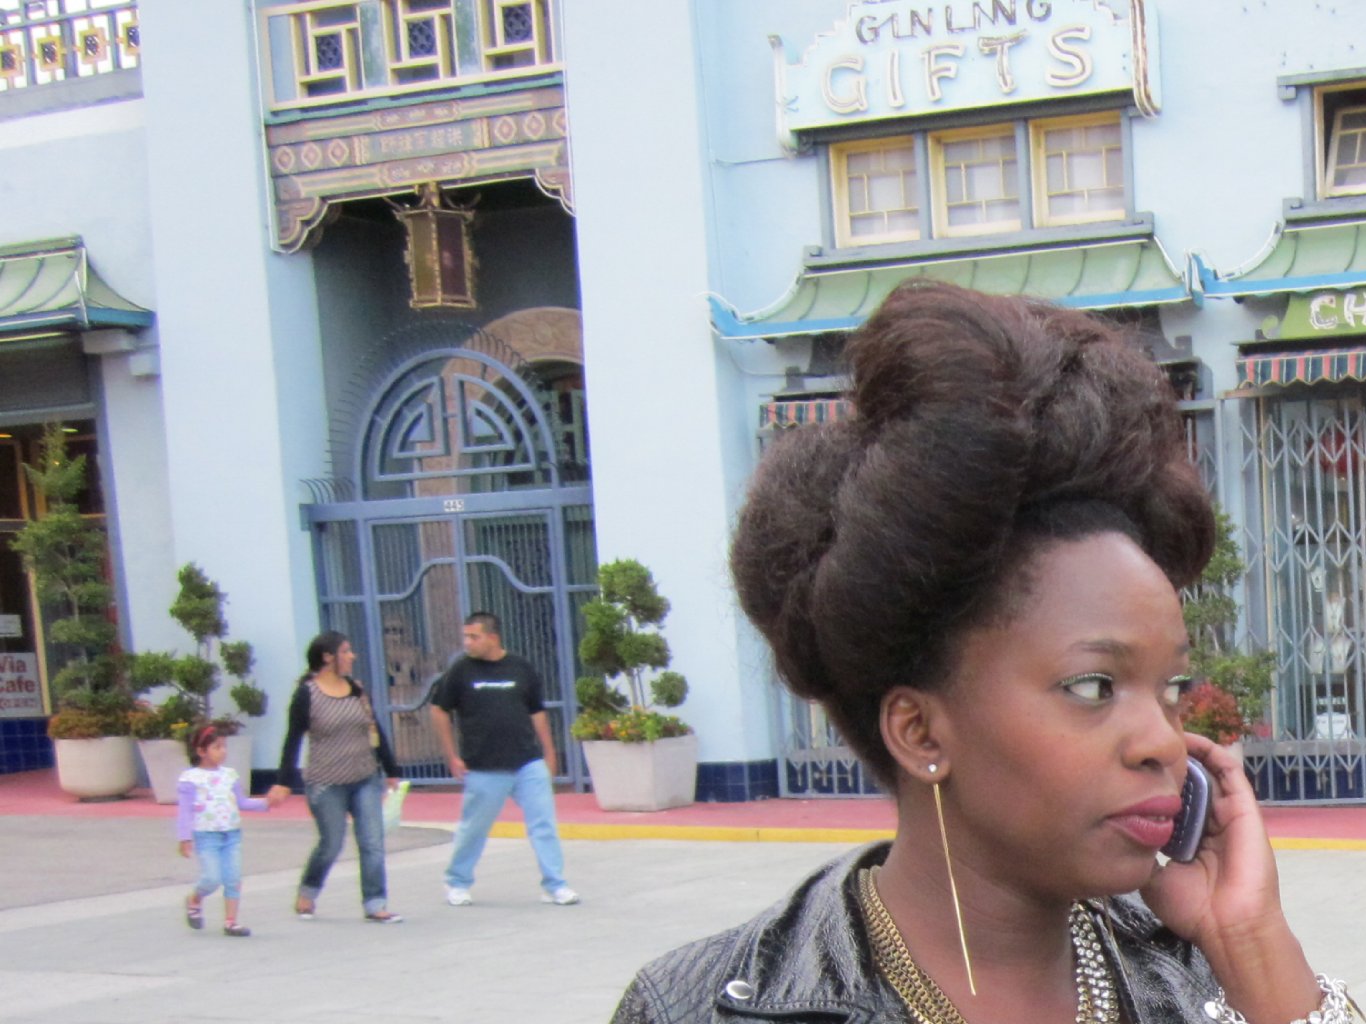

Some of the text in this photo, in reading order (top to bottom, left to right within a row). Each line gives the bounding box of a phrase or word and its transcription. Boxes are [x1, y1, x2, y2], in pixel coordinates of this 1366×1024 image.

[856, 0, 1053, 45] GIN LING
[821, 25, 1093, 115] GIFTS
